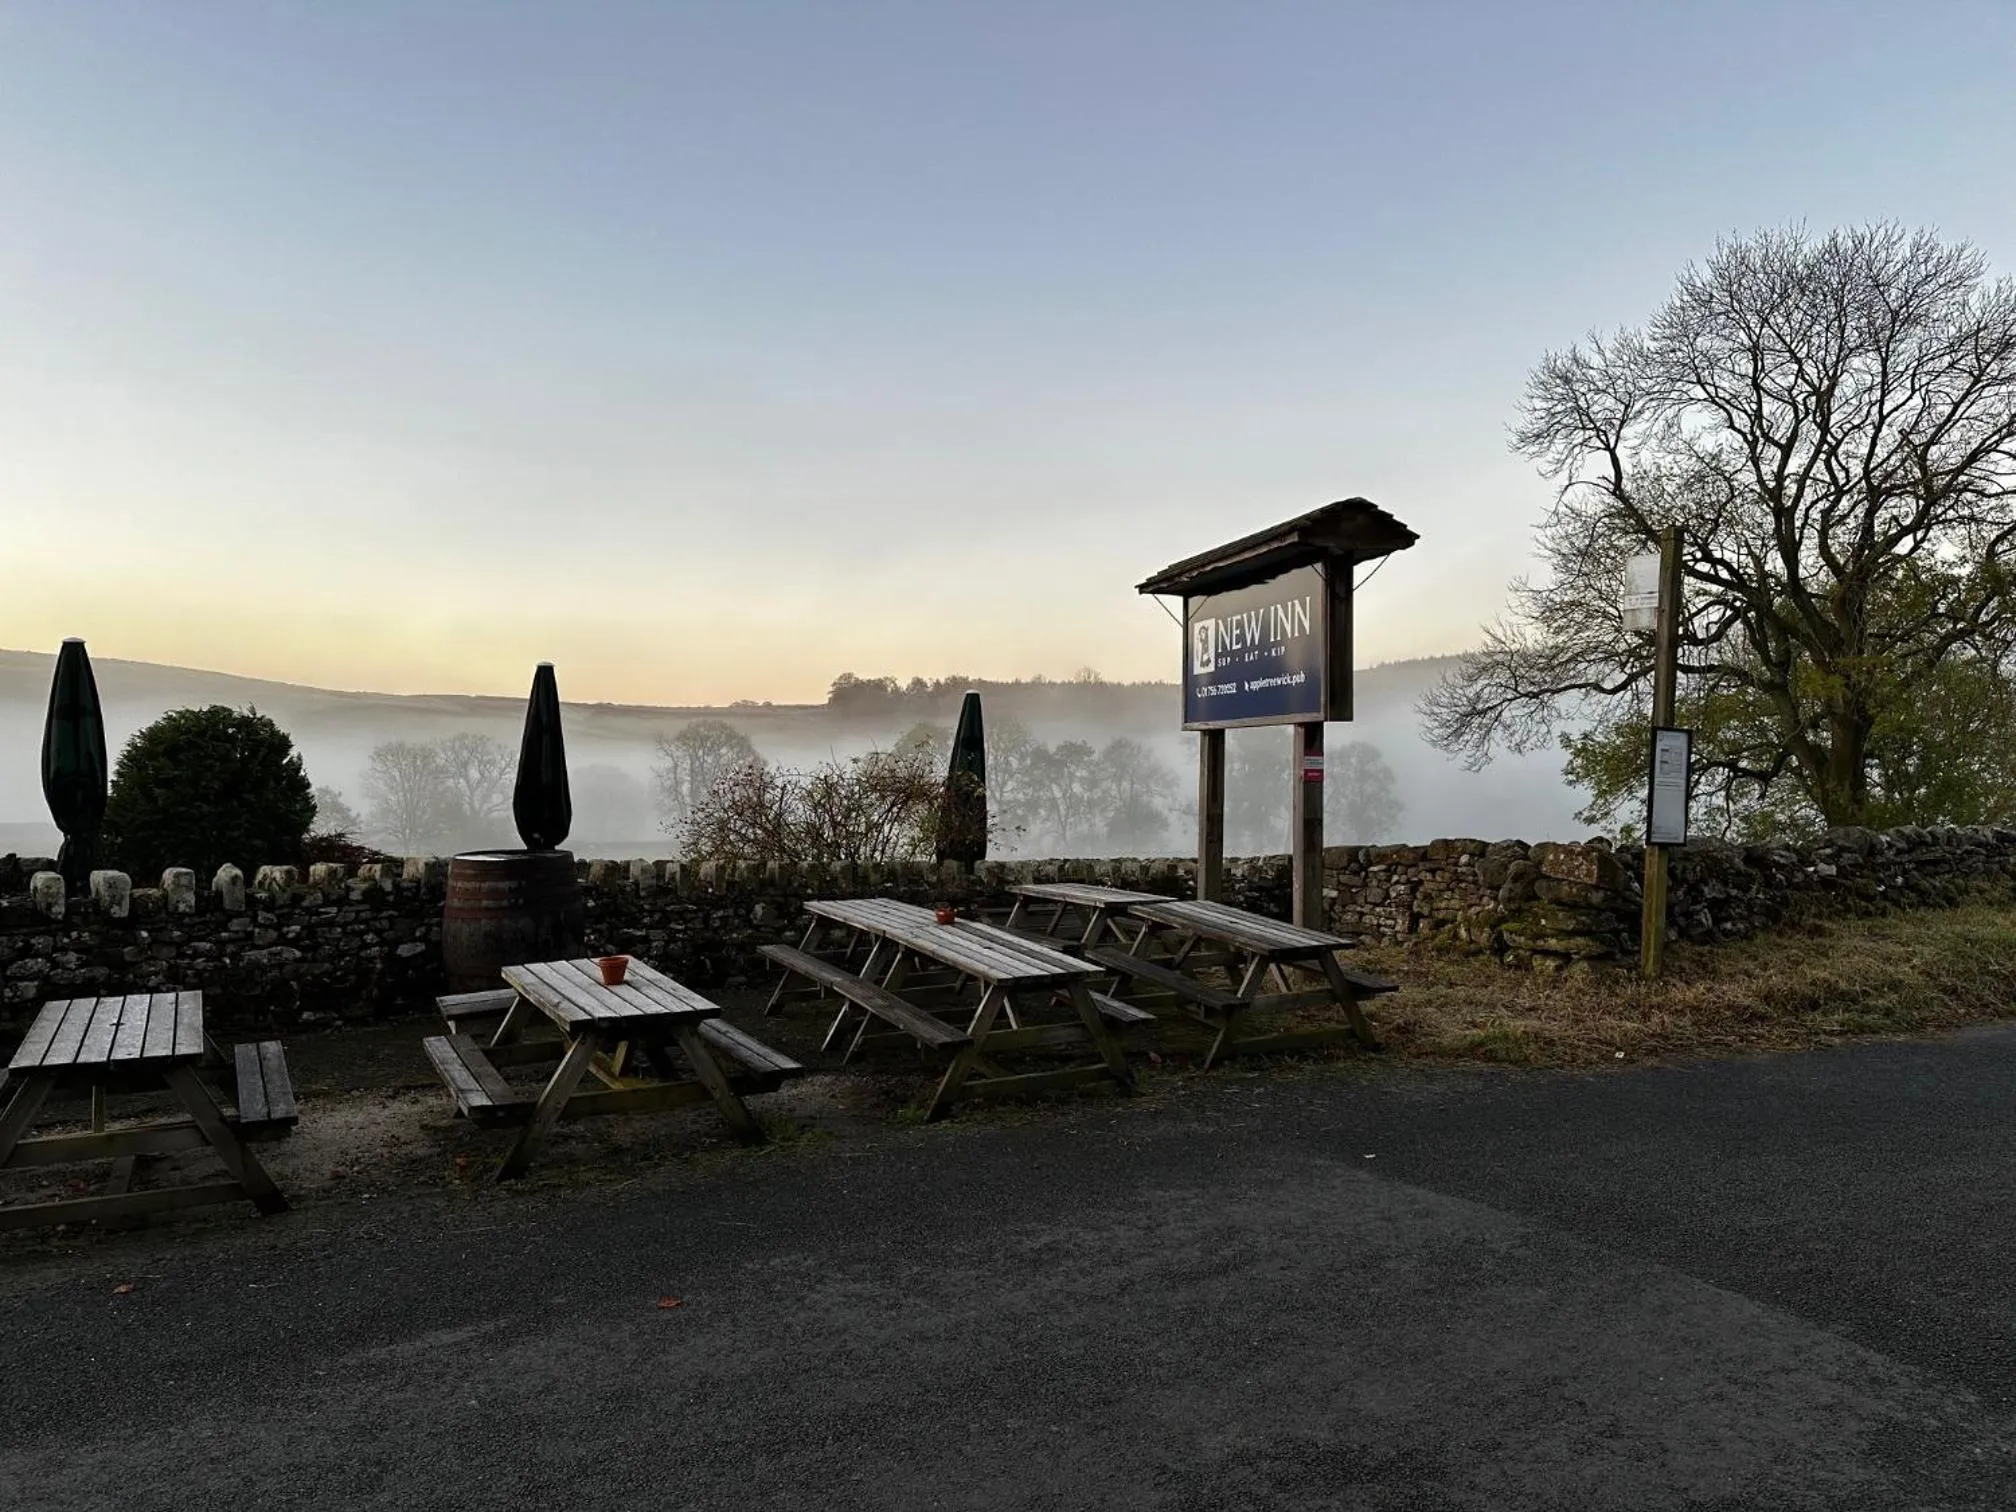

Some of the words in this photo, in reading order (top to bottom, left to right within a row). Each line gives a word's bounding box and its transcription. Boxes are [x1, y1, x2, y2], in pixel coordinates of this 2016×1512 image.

[1218, 608, 1264, 653] NEW
[1270, 597, 1311, 642] INN
[1218, 657, 1231, 667] SUP
[1245, 651, 1258, 662] EAT
[1271, 646, 1286, 657] KIP
